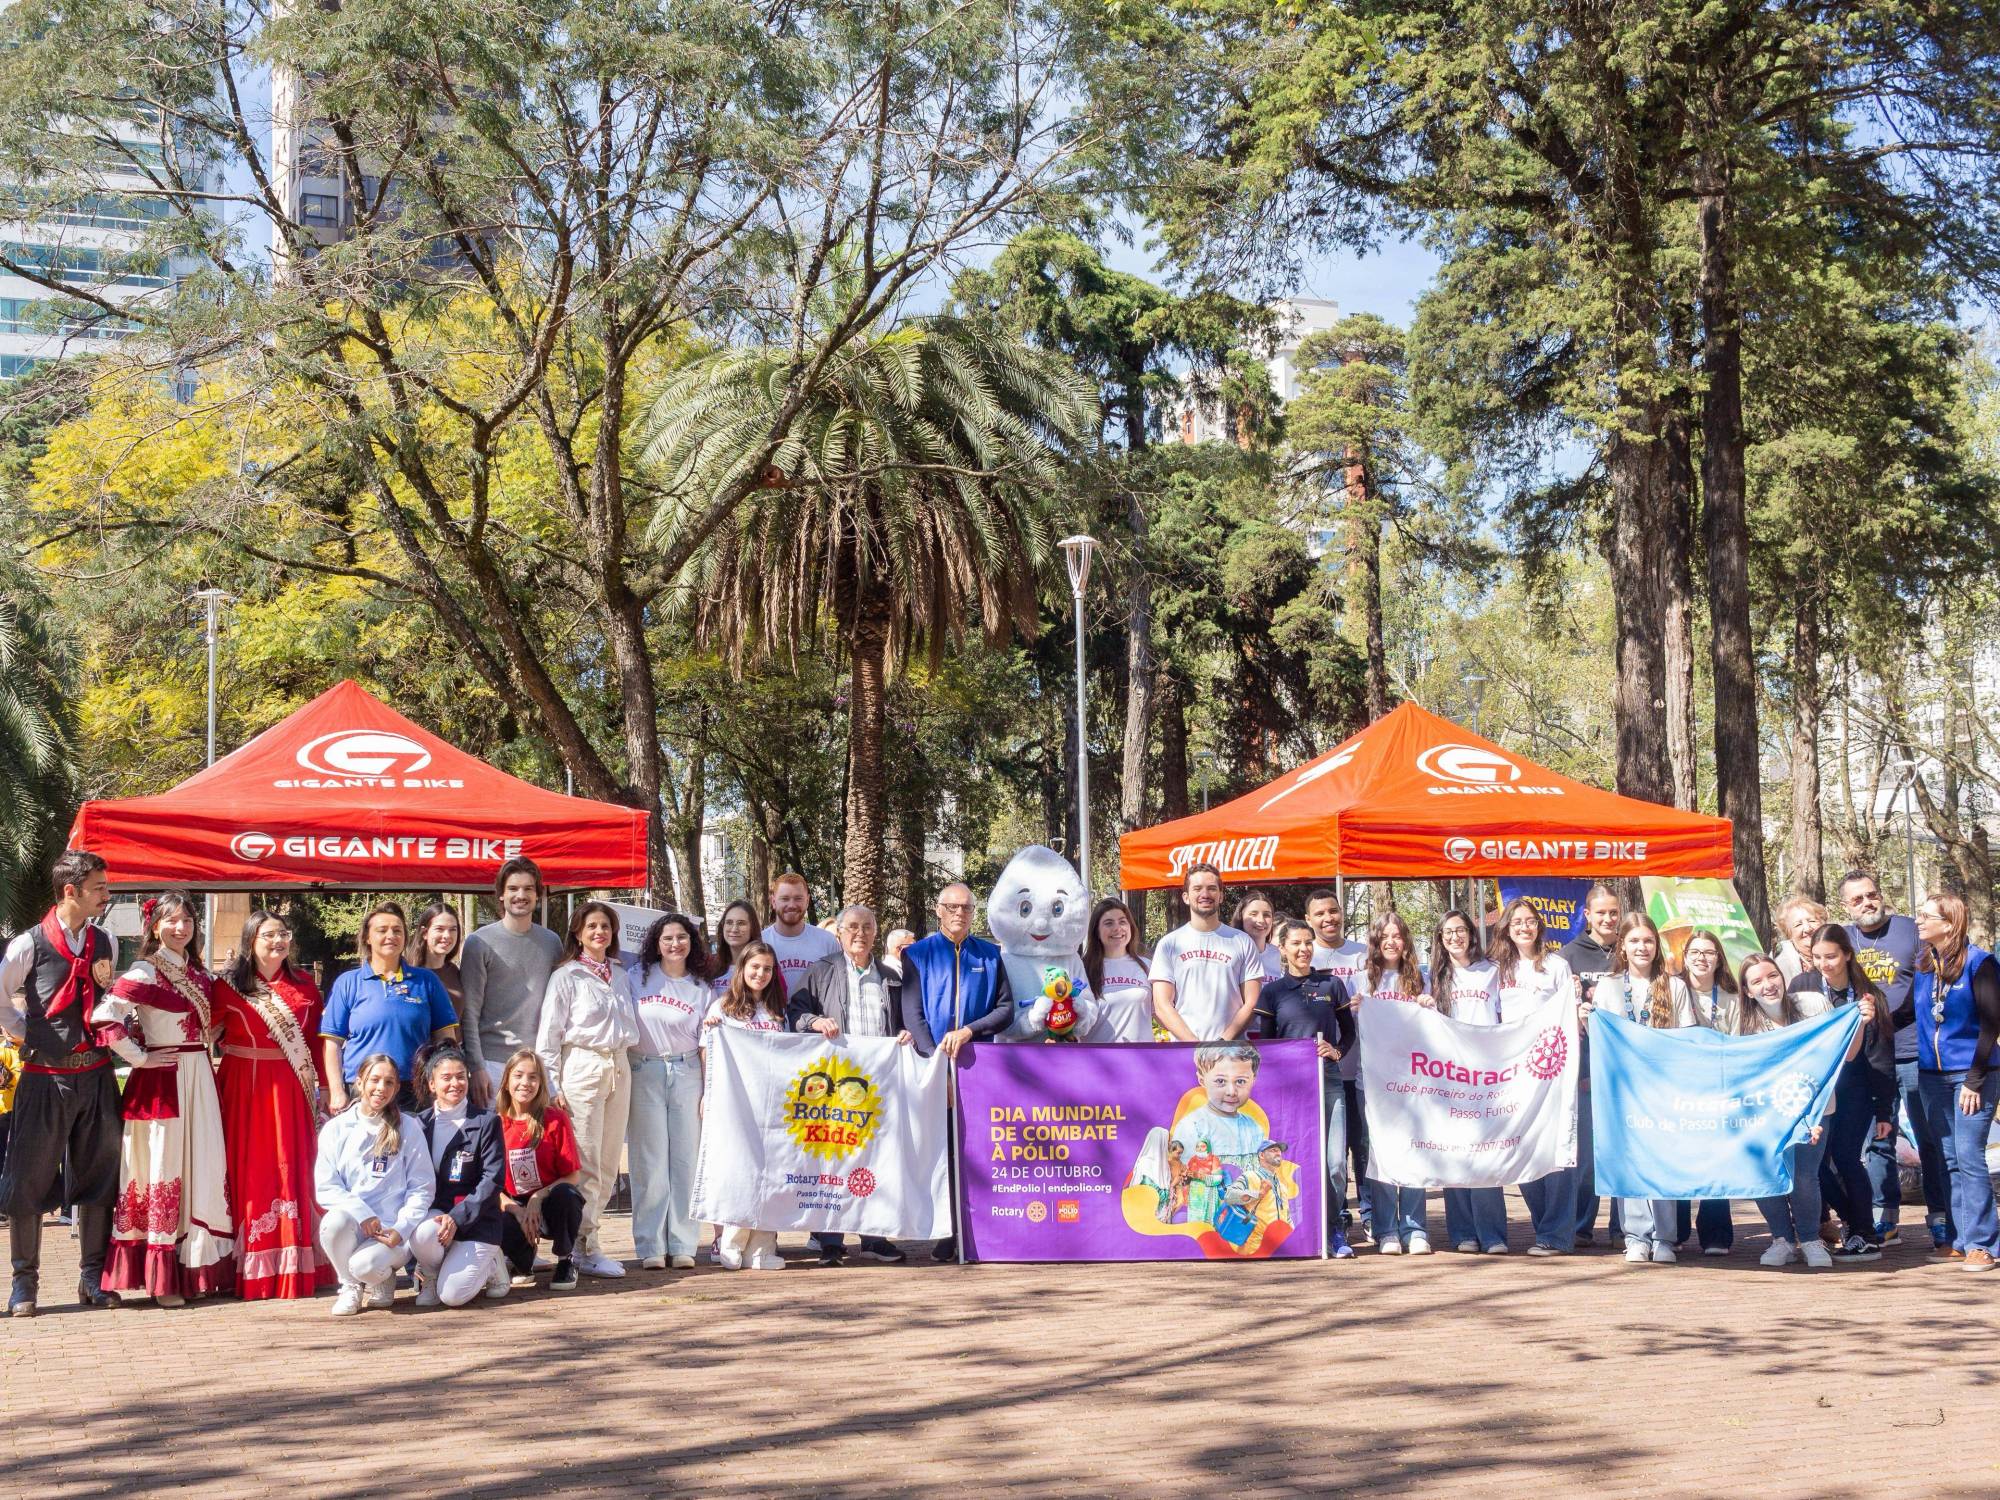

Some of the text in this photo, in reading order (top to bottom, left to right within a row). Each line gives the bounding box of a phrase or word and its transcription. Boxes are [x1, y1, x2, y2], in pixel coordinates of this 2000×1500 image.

[273, 778, 464, 789] GIGANTE BIKE
[1427, 785, 1565, 795] GIGANTE BIKE
[283, 836, 524, 860] GIGANTE BIKE
[1480, 840, 1648, 861] GIGANTE BIKE
[1180, 949, 1232, 963] ROTARACT
[640, 994, 695, 1015] ROTARACT
[1411, 1052, 1520, 1086] Rotaract
[1386, 1081, 1418, 1093] Clube
[1420, 1086, 1466, 1100] parceiro
[1469, 1092, 1483, 1101] do
[1450, 1101, 1520, 1119] Passo Fundo
[1673, 1090, 1767, 1113] Interact
[792, 1102, 874, 1128] Rotary
[990, 1105, 1126, 1122] DIA MUNDIAL
[1626, 1114, 1767, 1132] Club de Passo Fundo
[804, 1125, 859, 1146] Kids
[991, 1125, 1117, 1142] DE COMBATE
[991, 1142, 1070, 1161] À PÓLIO
[1410, 1139, 1449, 1152] Fundado
[991, 1165, 1102, 1178] 24 DE OUTUBRO
[796, 1190, 842, 1199] Passo Fundo
[992, 1184, 1041, 1193] #EndPolio
[1048, 1182, 1112, 1194] endpolio.org
[991, 1206, 1025, 1218] Rotary
